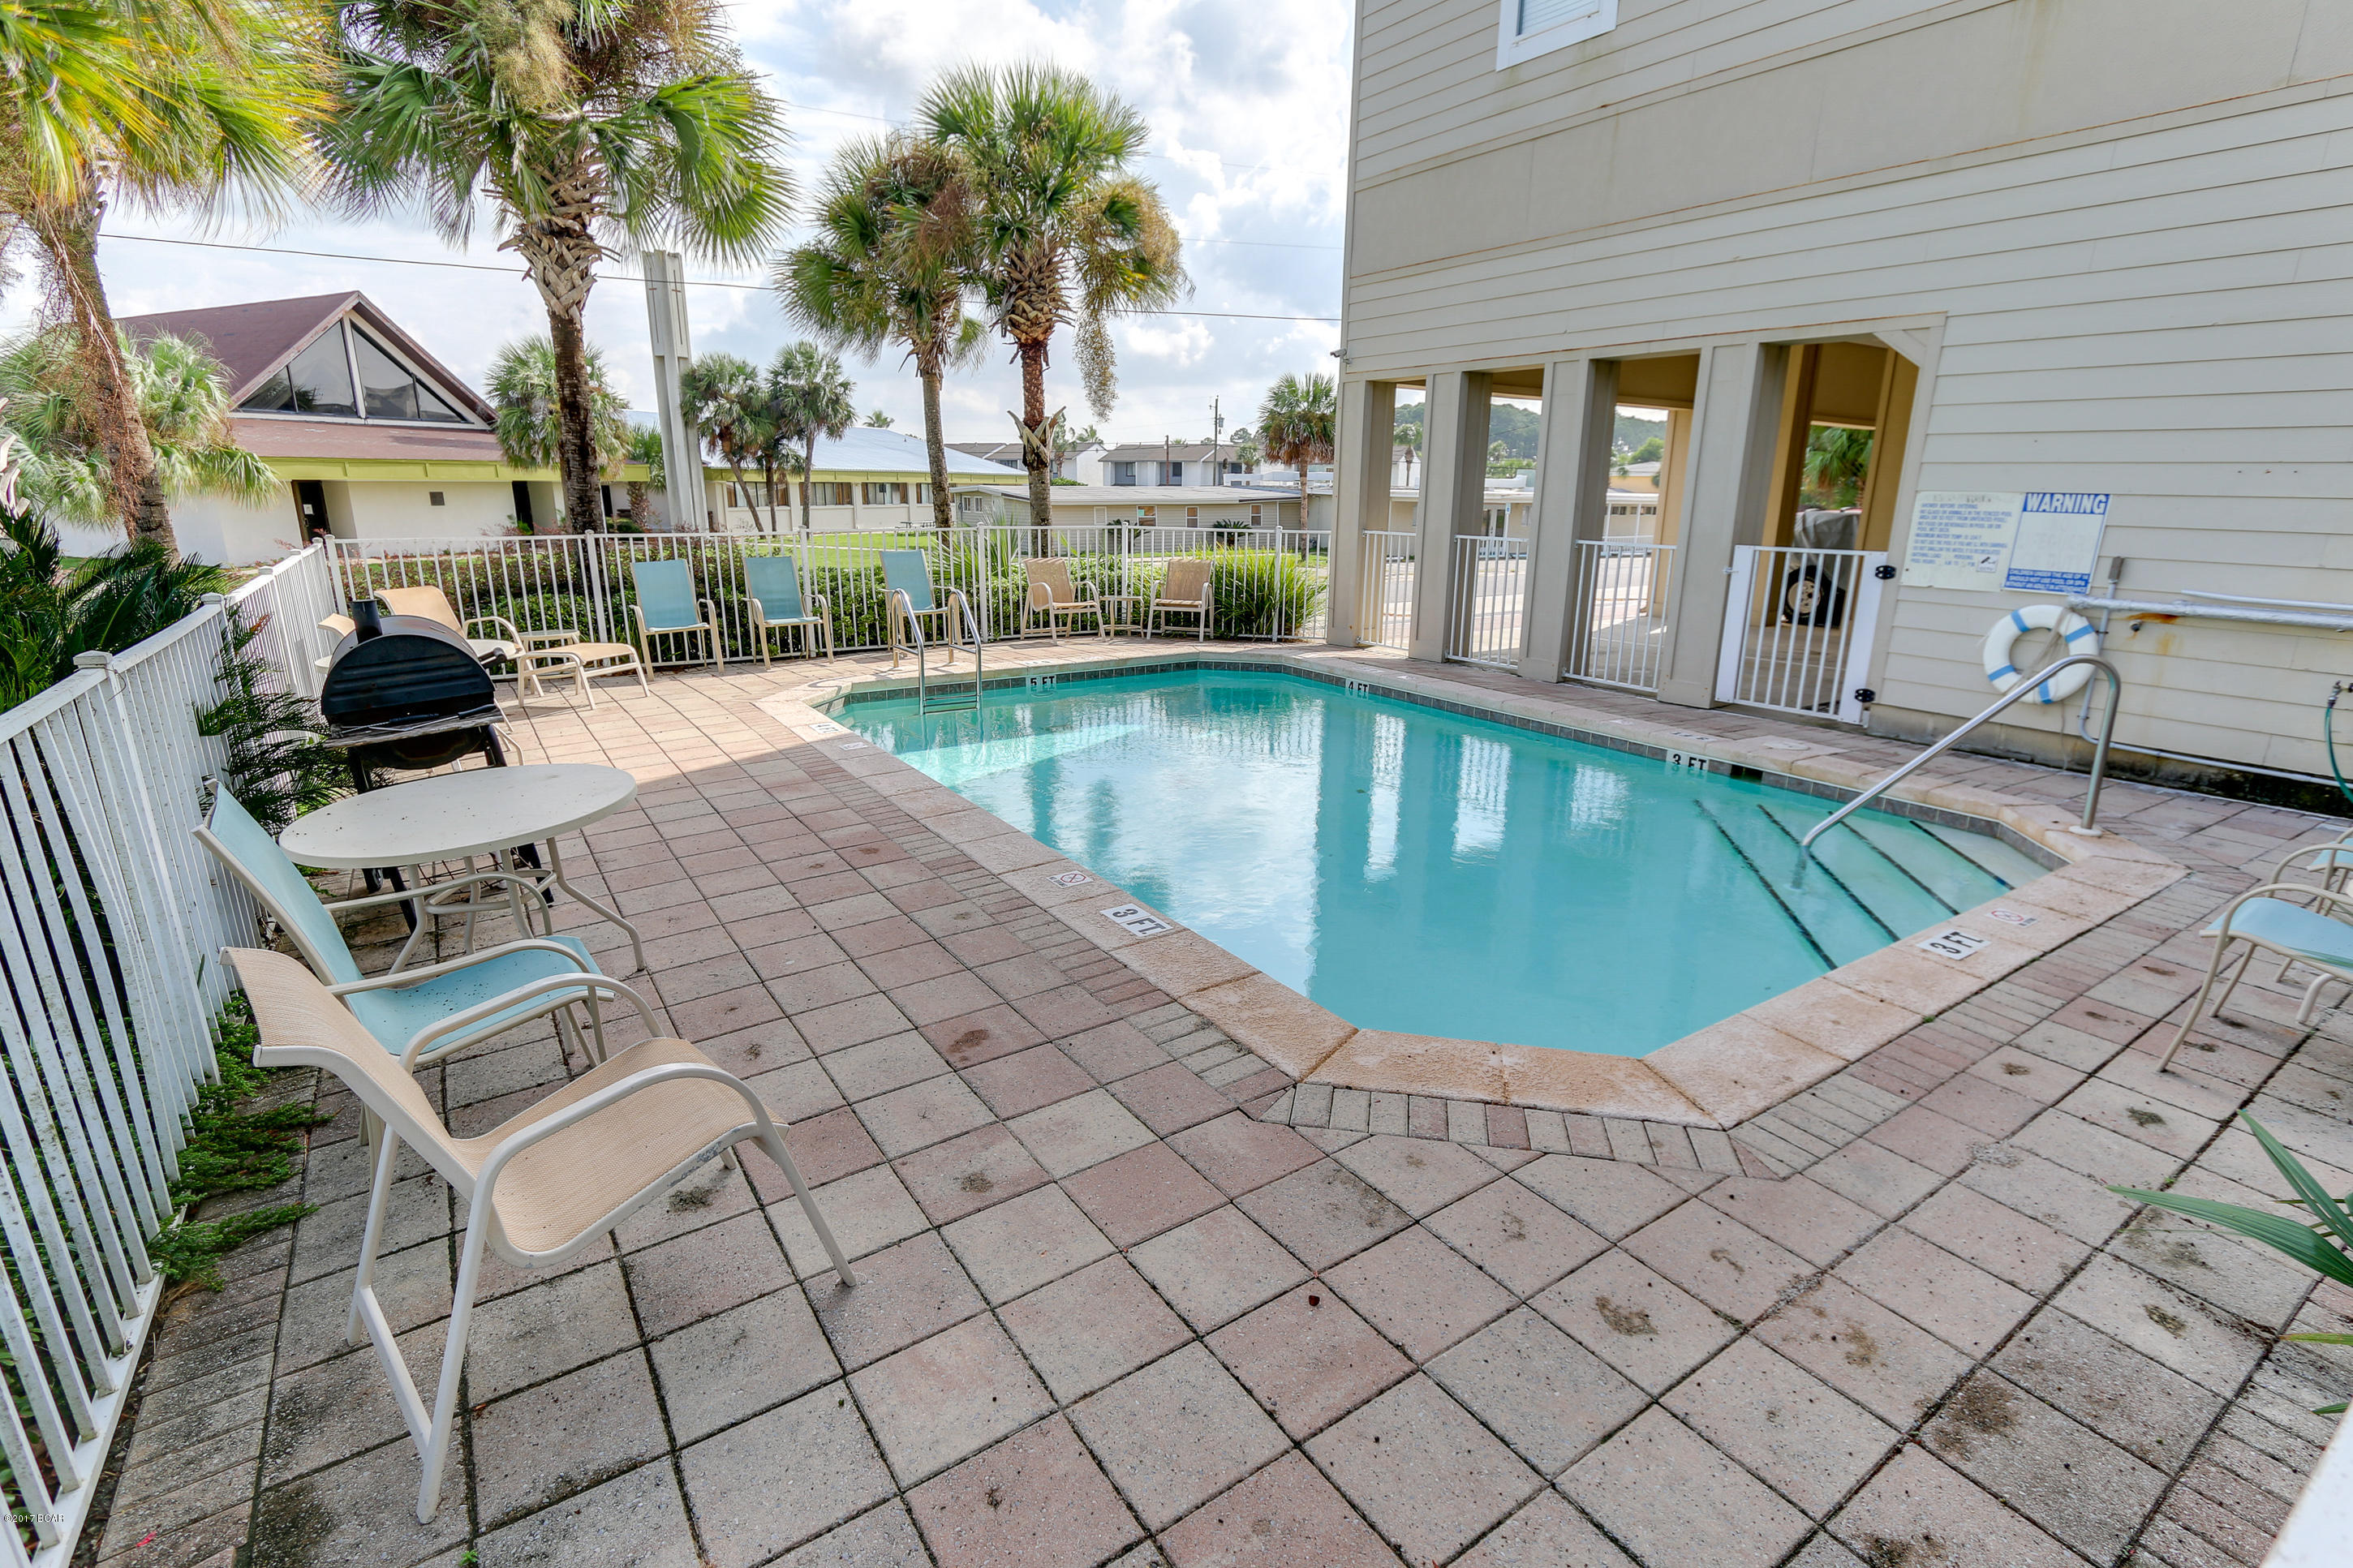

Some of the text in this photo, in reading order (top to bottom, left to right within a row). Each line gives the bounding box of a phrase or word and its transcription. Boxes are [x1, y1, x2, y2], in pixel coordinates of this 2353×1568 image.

[2027, 493, 2107, 513] WARNING
[1030, 676, 1055, 686] 5 FT
[1349, 681, 1368, 693] 4 FT
[1673, 754, 1706, 771] 3 FT
[1112, 909, 1138, 918] 3
[1929, 943, 1961, 954] 3
